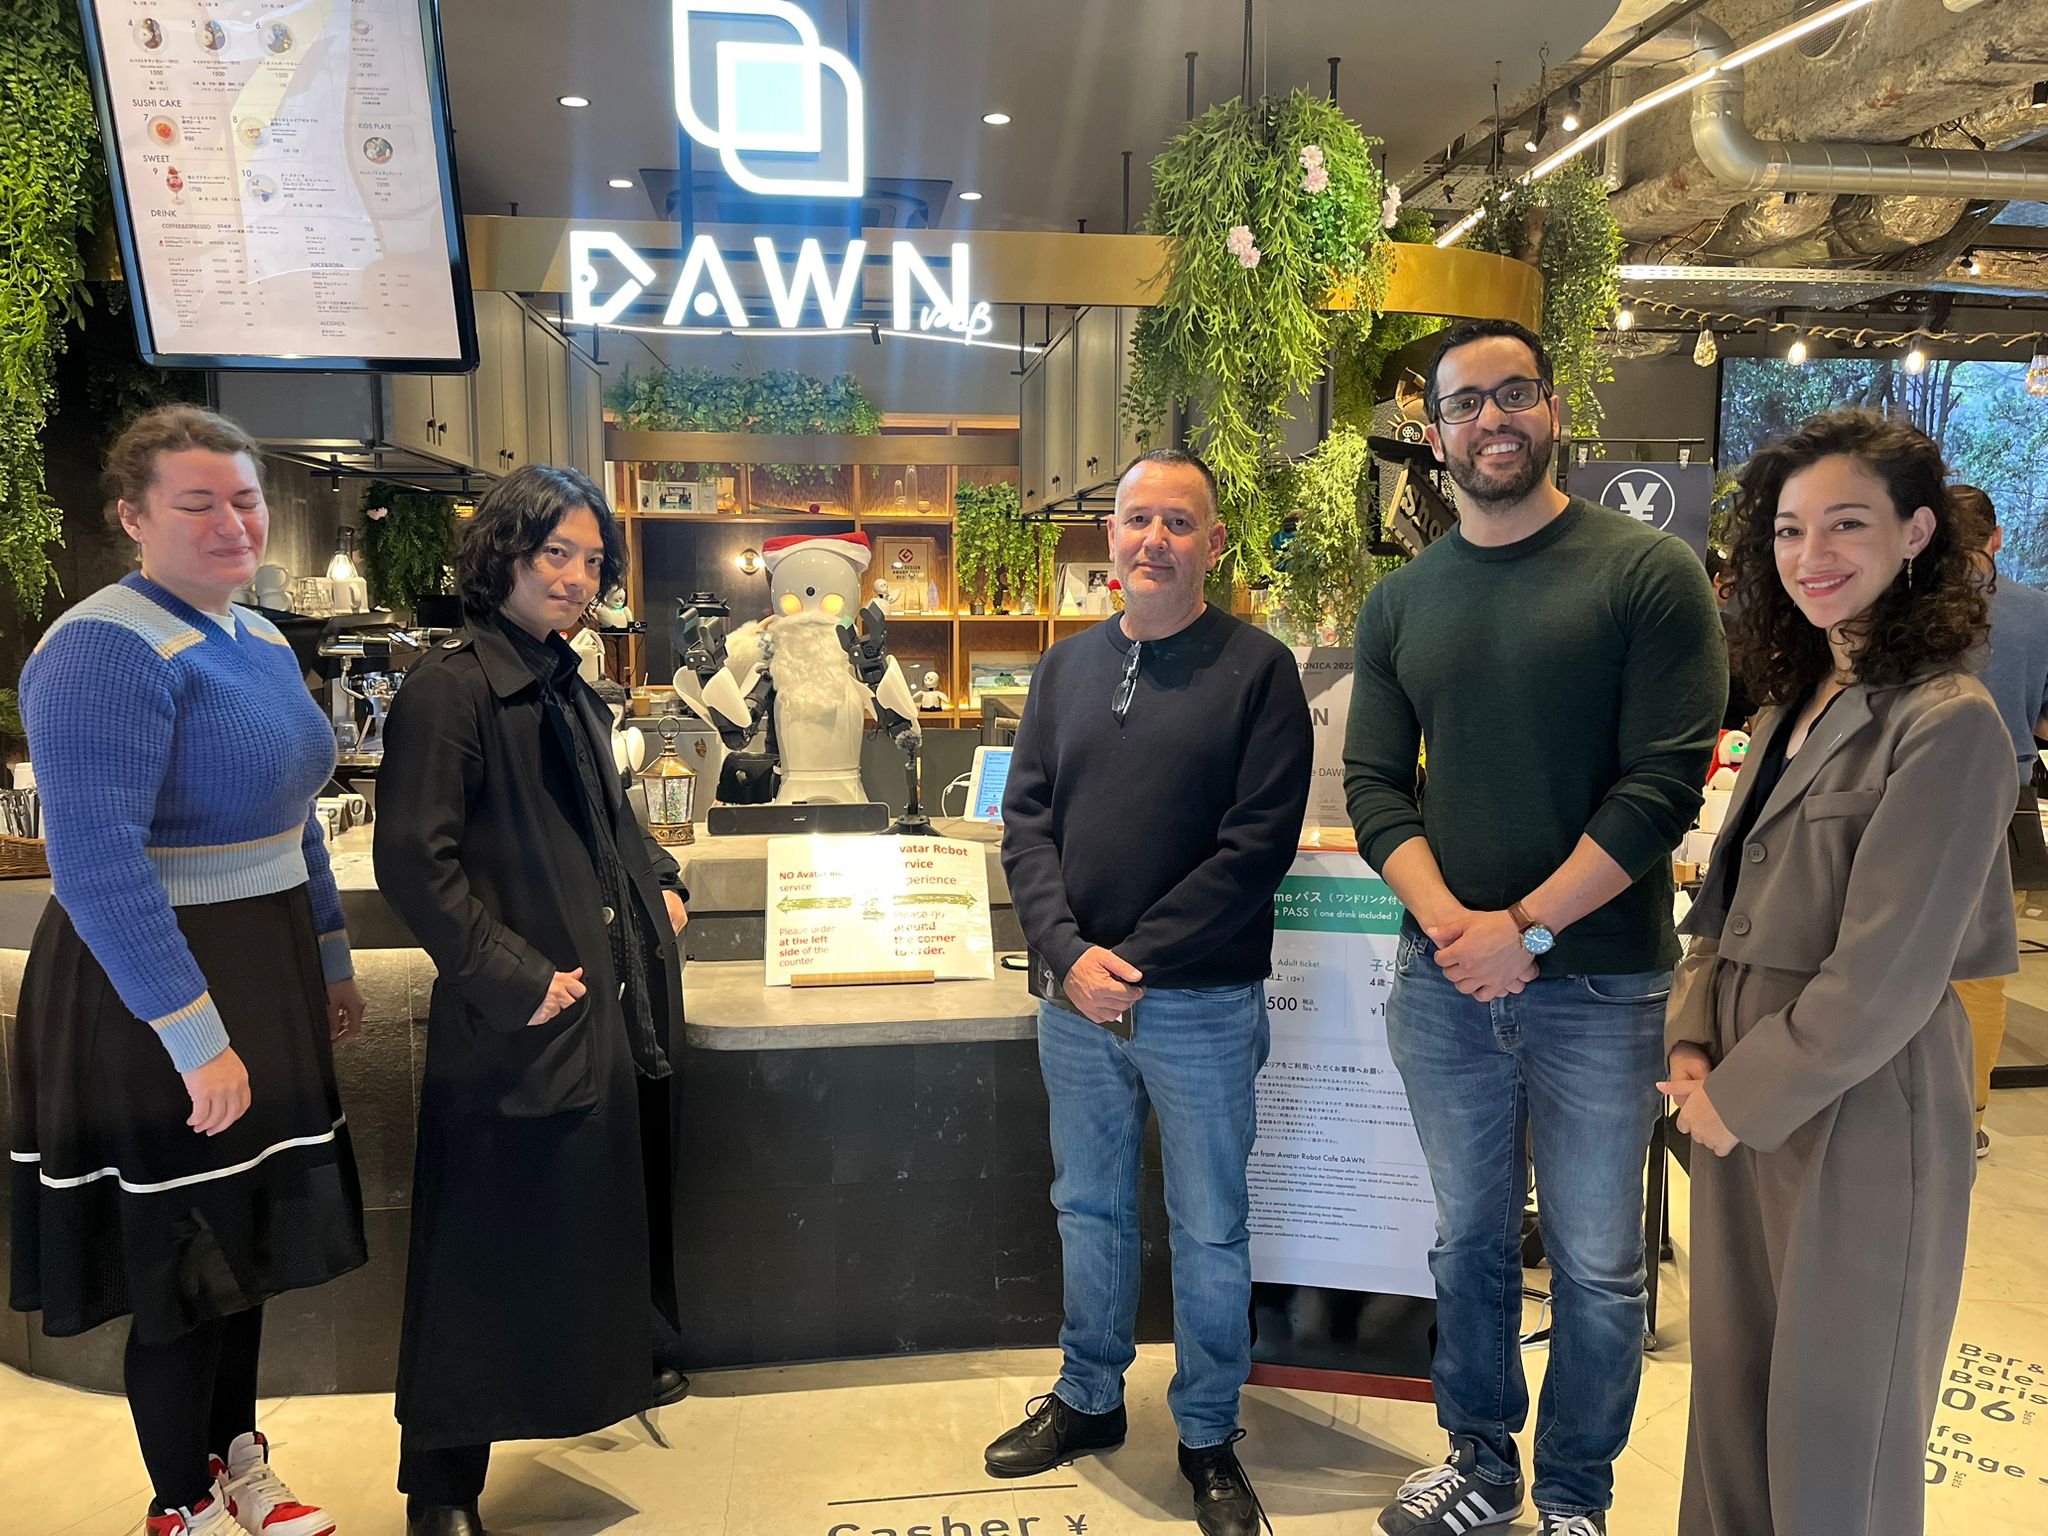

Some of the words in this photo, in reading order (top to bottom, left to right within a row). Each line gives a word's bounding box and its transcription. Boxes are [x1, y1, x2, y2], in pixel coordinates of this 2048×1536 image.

[191, 20, 196, 28] 5
[255, 21, 261, 30] 6
[132, 99, 157, 107] SUSHI
[159, 99, 182, 108] CAKE
[143, 114, 149, 122] 7
[143, 154, 170, 163] SWEET
[152, 168, 158, 176] 9
[241, 169, 252, 177] 10
[151, 209, 177, 218] DRINK
[569, 230, 970, 331] DAWN
[1298, 662, 1332, 670] RONICA
[899, 844, 930, 853] vatar
[905, 858, 933, 869] rvice
[779, 871, 795, 880] NO
[906, 874, 957, 887] perience
[779, 883, 812, 892] service
[1274, 890, 1322, 903] meパス
[1282, 906, 1309, 918] PASS
[779, 938, 789, 947] at
[792, 937, 809, 945] the
[811, 935, 828, 944] left
[917, 935, 957, 944] corner
[779, 948, 800, 957] side
[802, 947, 812, 955] of
[779, 958, 814, 967] counter
[1278, 958, 1298, 967] Adult
[1299, 959, 1320, 968] ticket
[1266, 996, 1297, 1011] 500
[1263, 1061, 1384, 1075] エリアをご利用いただくお客様へお願い
[1260, 1150, 1276, 1158] from
[1277, 1151, 1300, 1159] Avatar
[1301, 1153, 1321, 1161] Robot
[1340, 1156, 1366, 1164] DAWN
[1959, 1342, 2023, 1367] Bar
[1941, 1387, 2016, 1423] 06
[1937, 1425, 1973, 1445] fe
[1928, 1442, 2026, 1478] unge
